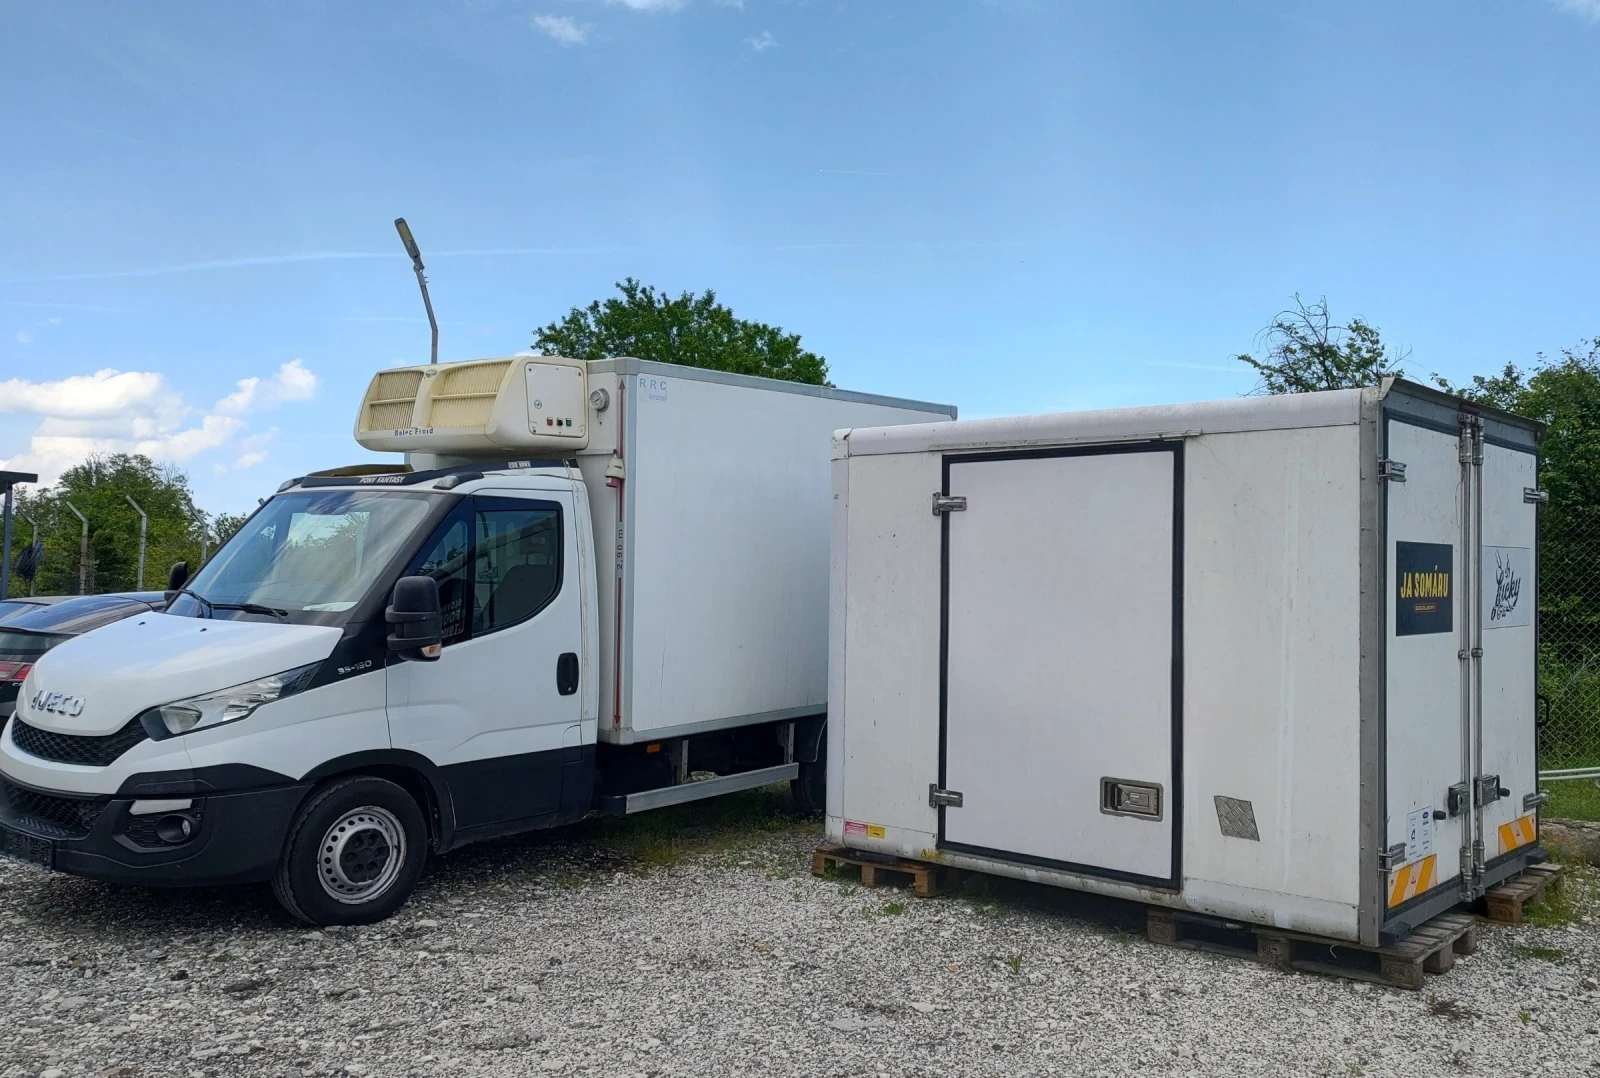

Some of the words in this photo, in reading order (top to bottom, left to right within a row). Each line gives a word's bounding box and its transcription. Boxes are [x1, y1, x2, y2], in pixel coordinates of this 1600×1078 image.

[394, 429, 413, 438] Relec
[414, 427, 434, 436] Froid
[359, 477, 377, 485] PONY
[376, 476, 406, 485] FANTASY
[1400, 572, 1413, 599] JA
[1414, 564, 1449, 598] SOMÁRU
[31, 689, 86, 718] IVECO
